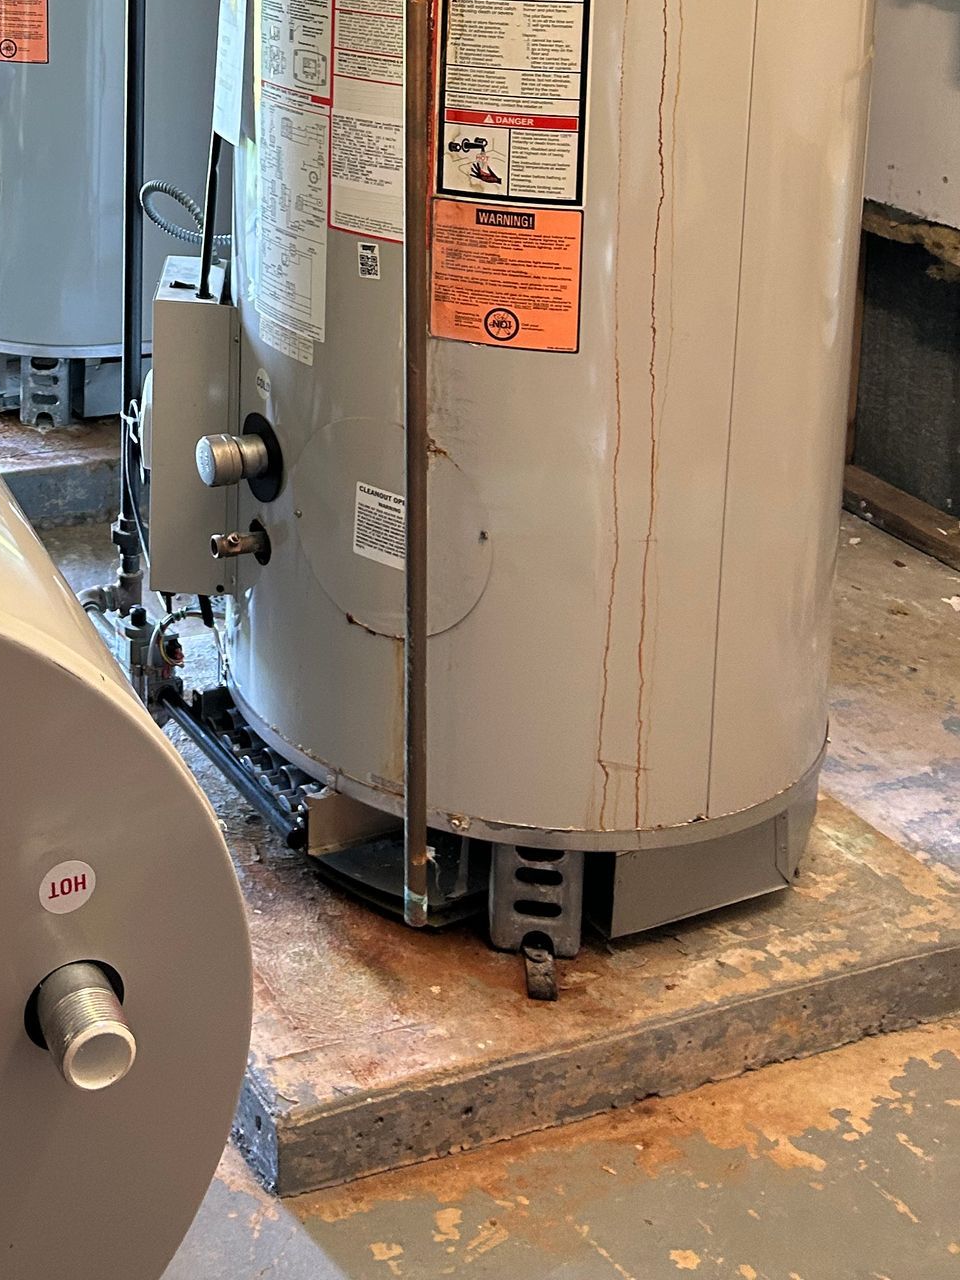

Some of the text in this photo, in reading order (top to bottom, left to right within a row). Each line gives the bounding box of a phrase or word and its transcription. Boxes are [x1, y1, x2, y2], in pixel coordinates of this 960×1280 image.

[495, 116, 533, 126] DANGER
[479, 211, 533, 227] WARNING!
[359, 485, 392, 502] CLEANOUT
[48, 873, 87, 899] HOT
